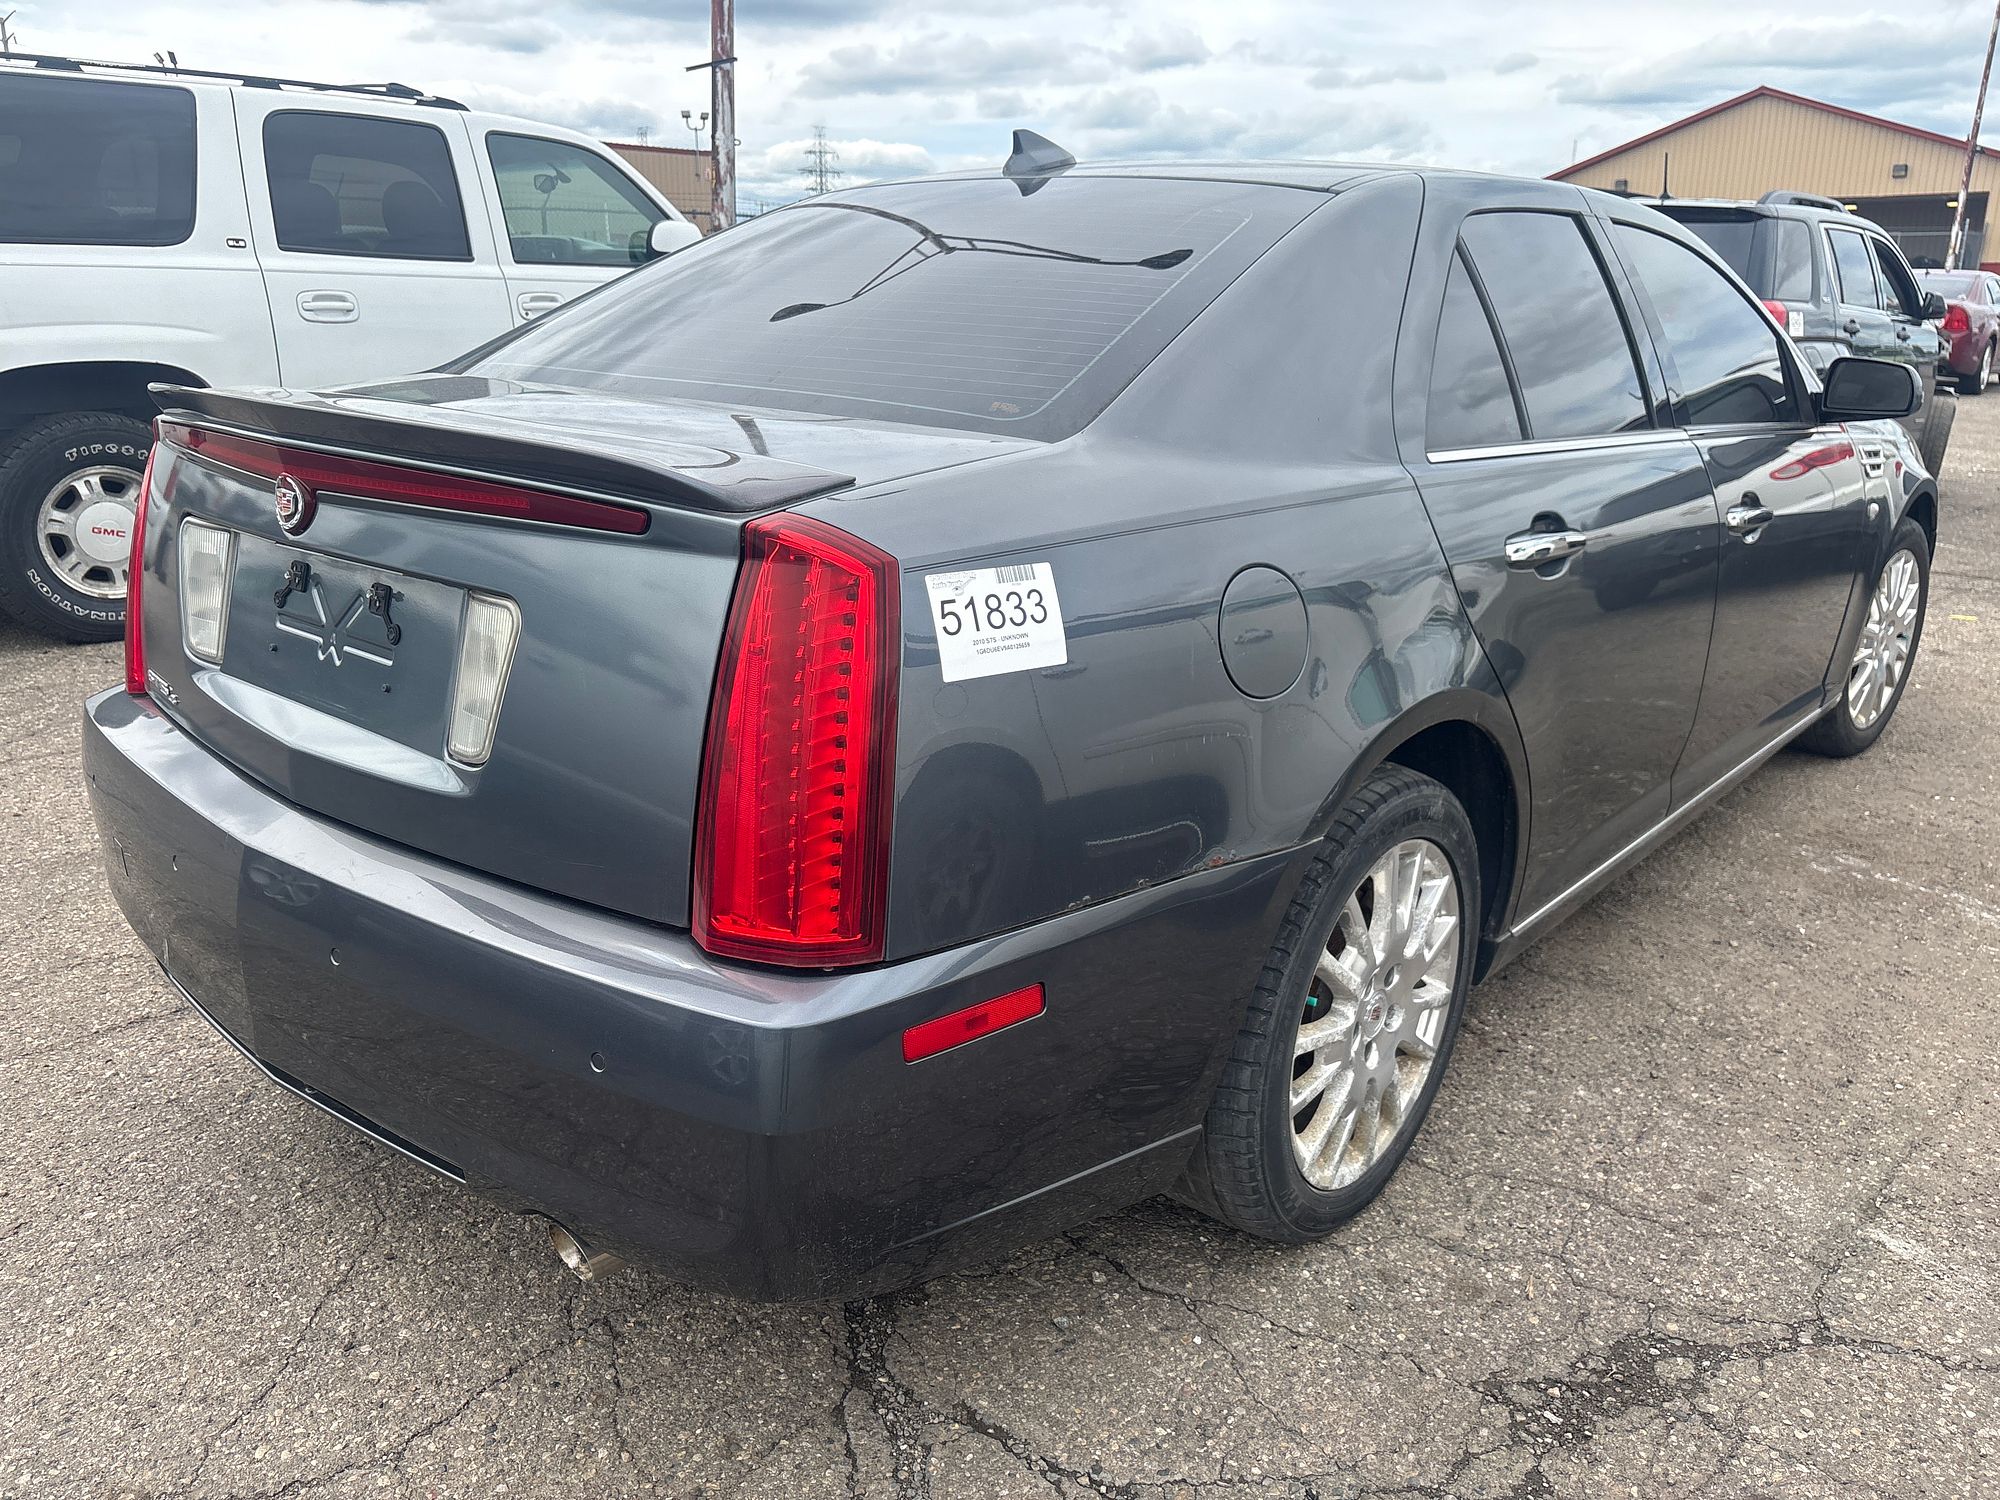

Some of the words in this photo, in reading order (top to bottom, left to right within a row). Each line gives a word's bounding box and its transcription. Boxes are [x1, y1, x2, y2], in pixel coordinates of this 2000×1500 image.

[91, 526, 126, 538] GMC
[940, 588, 1048, 636] 51833
[1000, 632, 1029, 642] UNKNOWN
